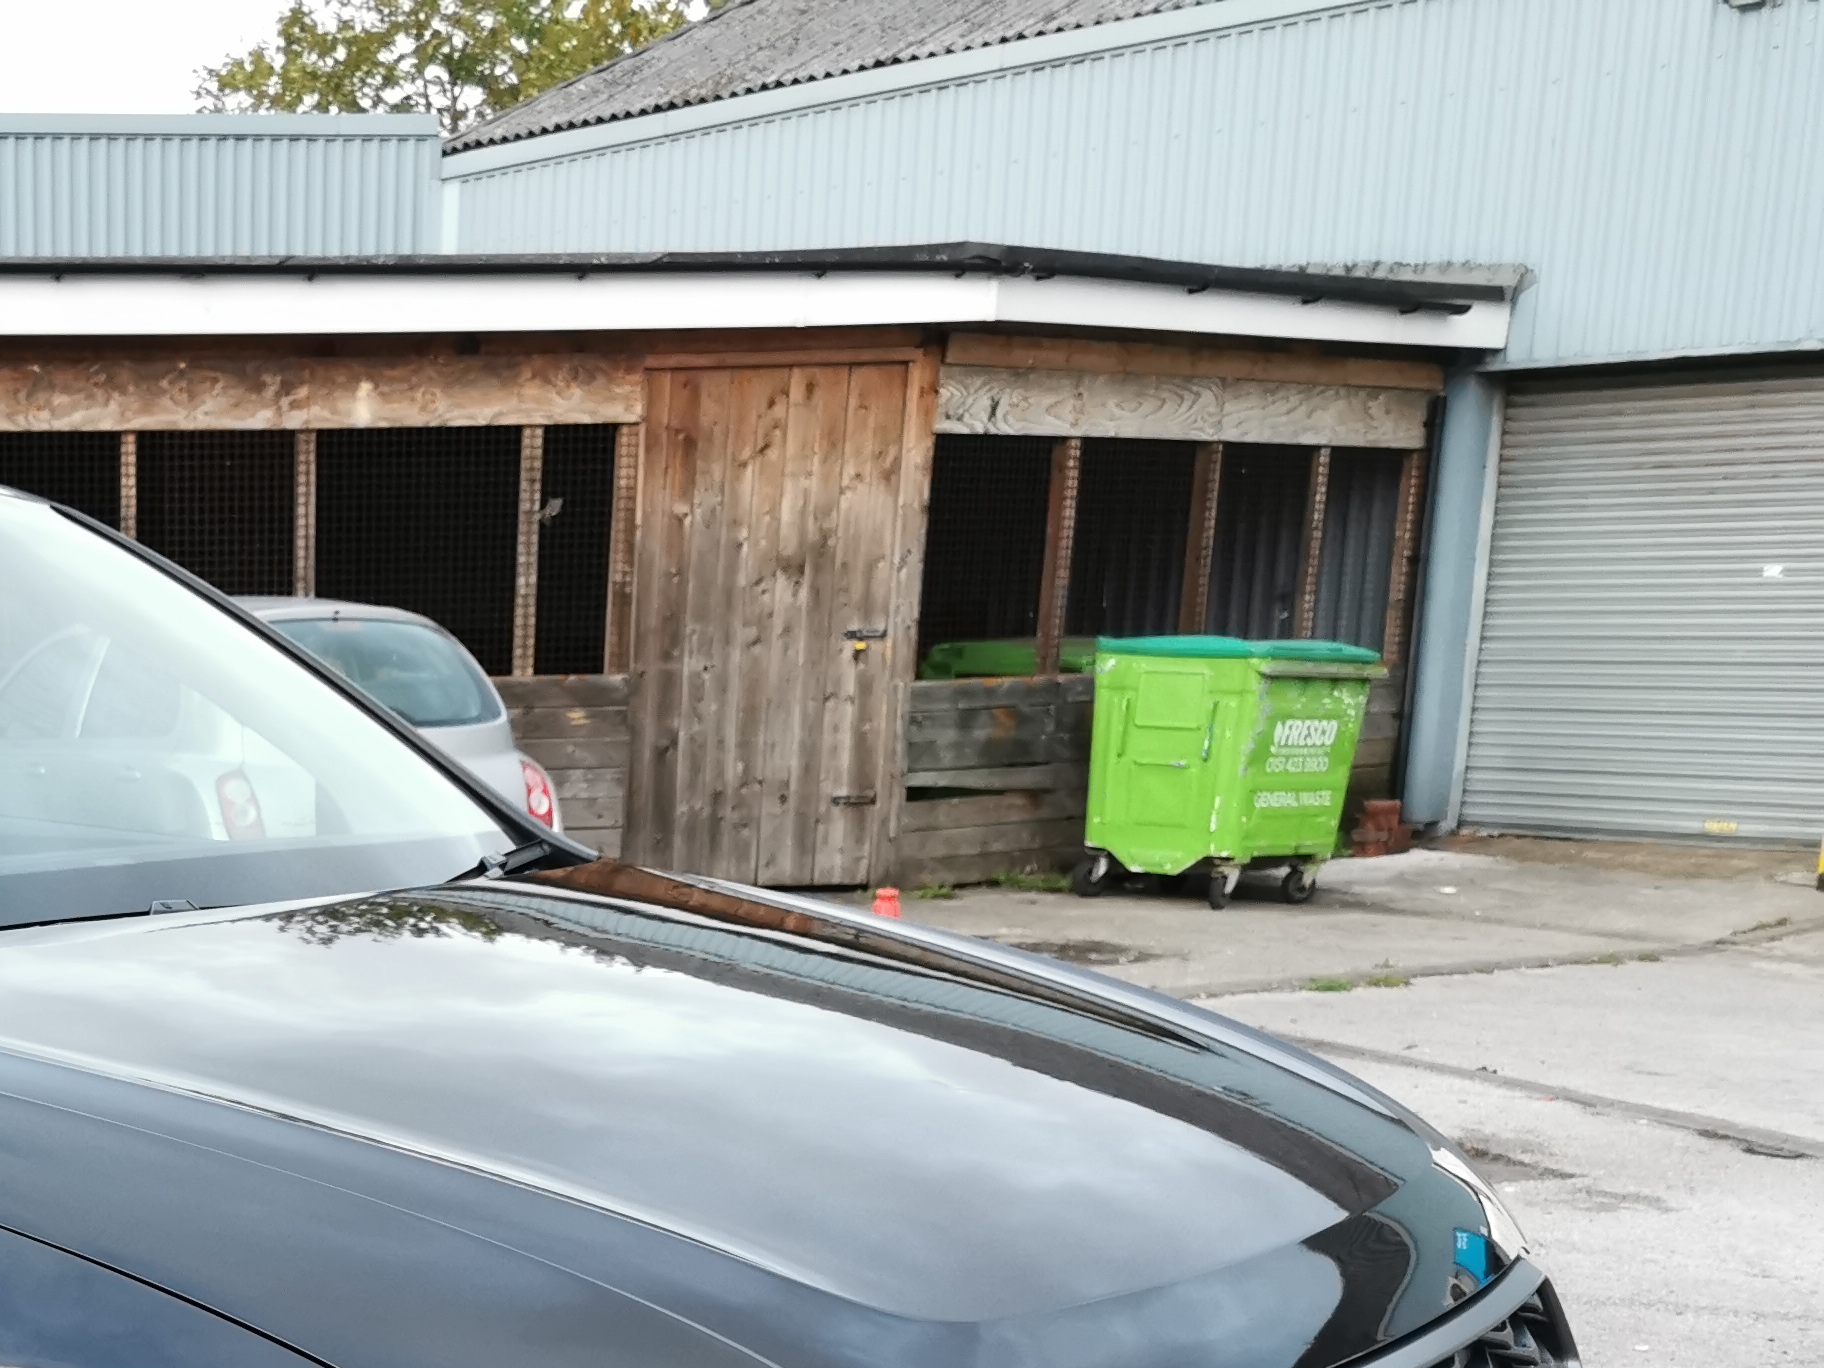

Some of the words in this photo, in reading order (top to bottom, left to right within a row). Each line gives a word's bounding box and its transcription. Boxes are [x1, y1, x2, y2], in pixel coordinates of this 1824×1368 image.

[1278, 718, 1338, 746] FRESCO
[1254, 791, 1298, 808] GENERAL
[1298, 790, 1332, 806] WASTE
